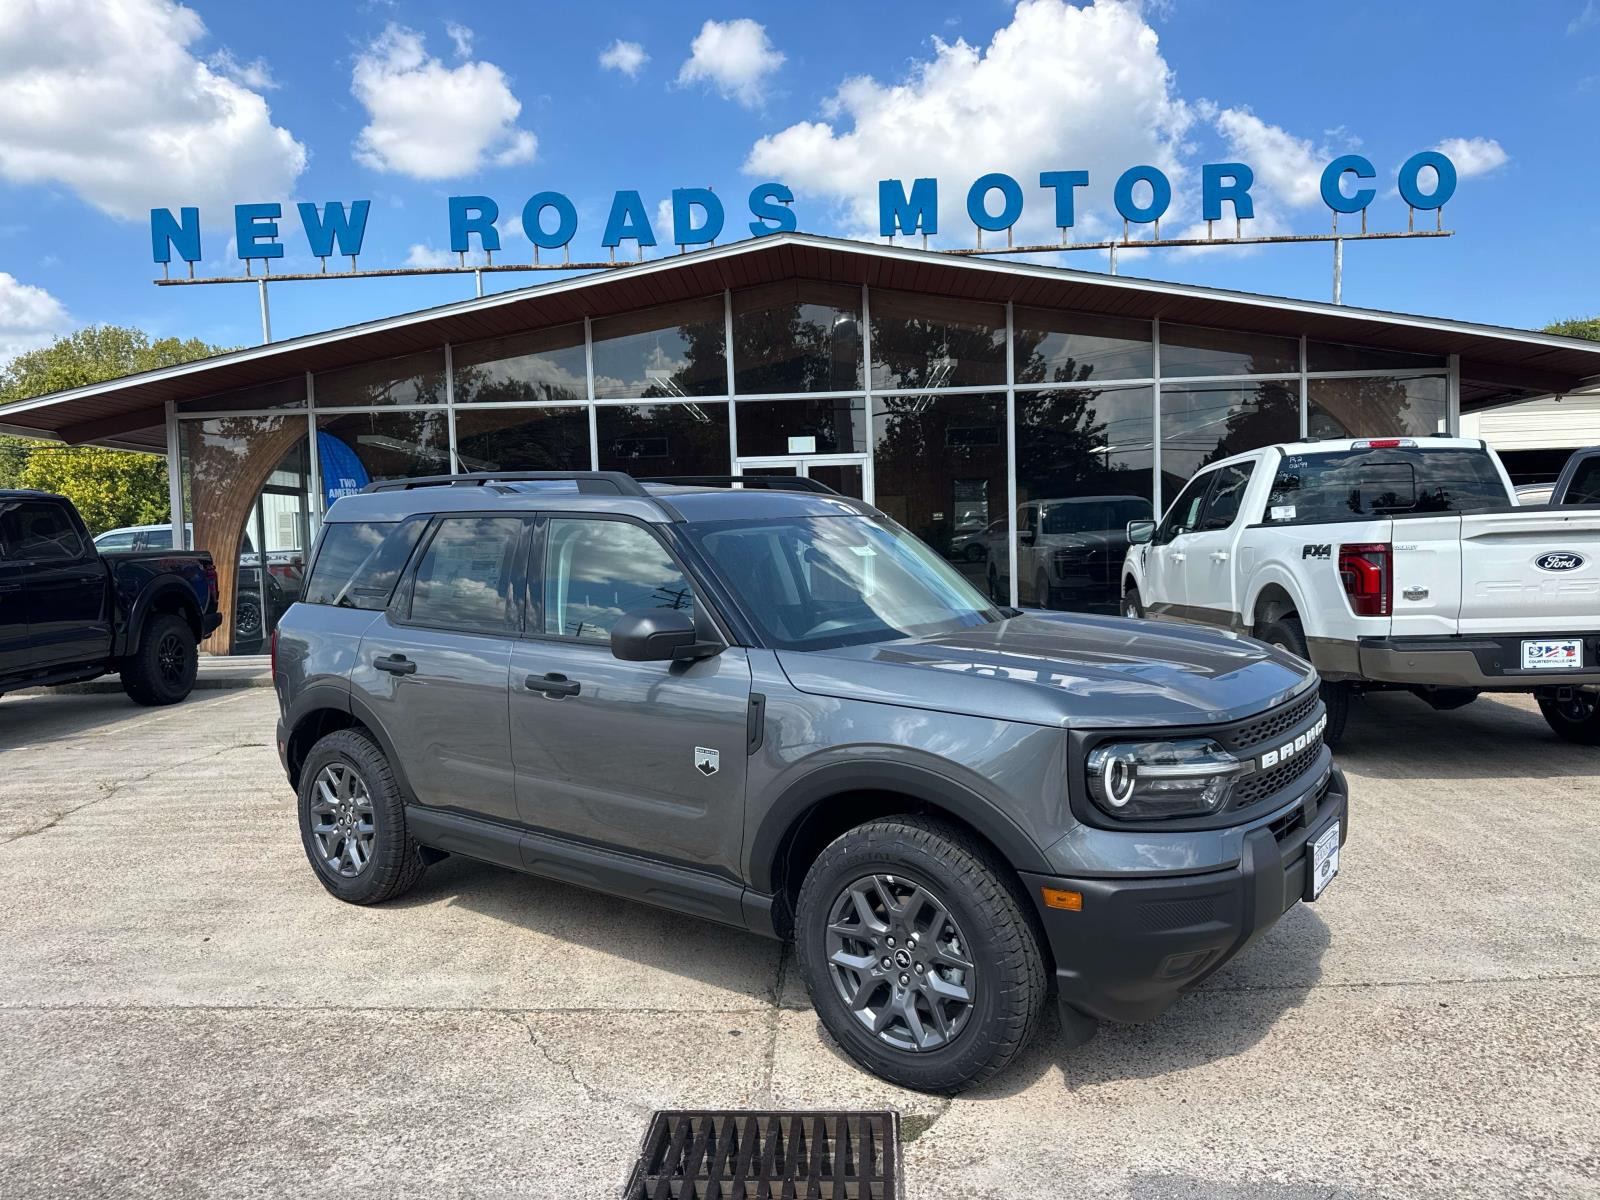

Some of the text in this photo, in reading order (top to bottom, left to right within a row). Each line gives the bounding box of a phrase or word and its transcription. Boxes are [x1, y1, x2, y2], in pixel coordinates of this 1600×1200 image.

[151, 152, 1457, 264] NEW ROADS MOTOR CO
[338, 478, 357, 488] TWO
[1302, 544, 1332, 560] FX4
[1544, 555, 1576, 569] Ford
[1261, 713, 1328, 769] BRONCO
